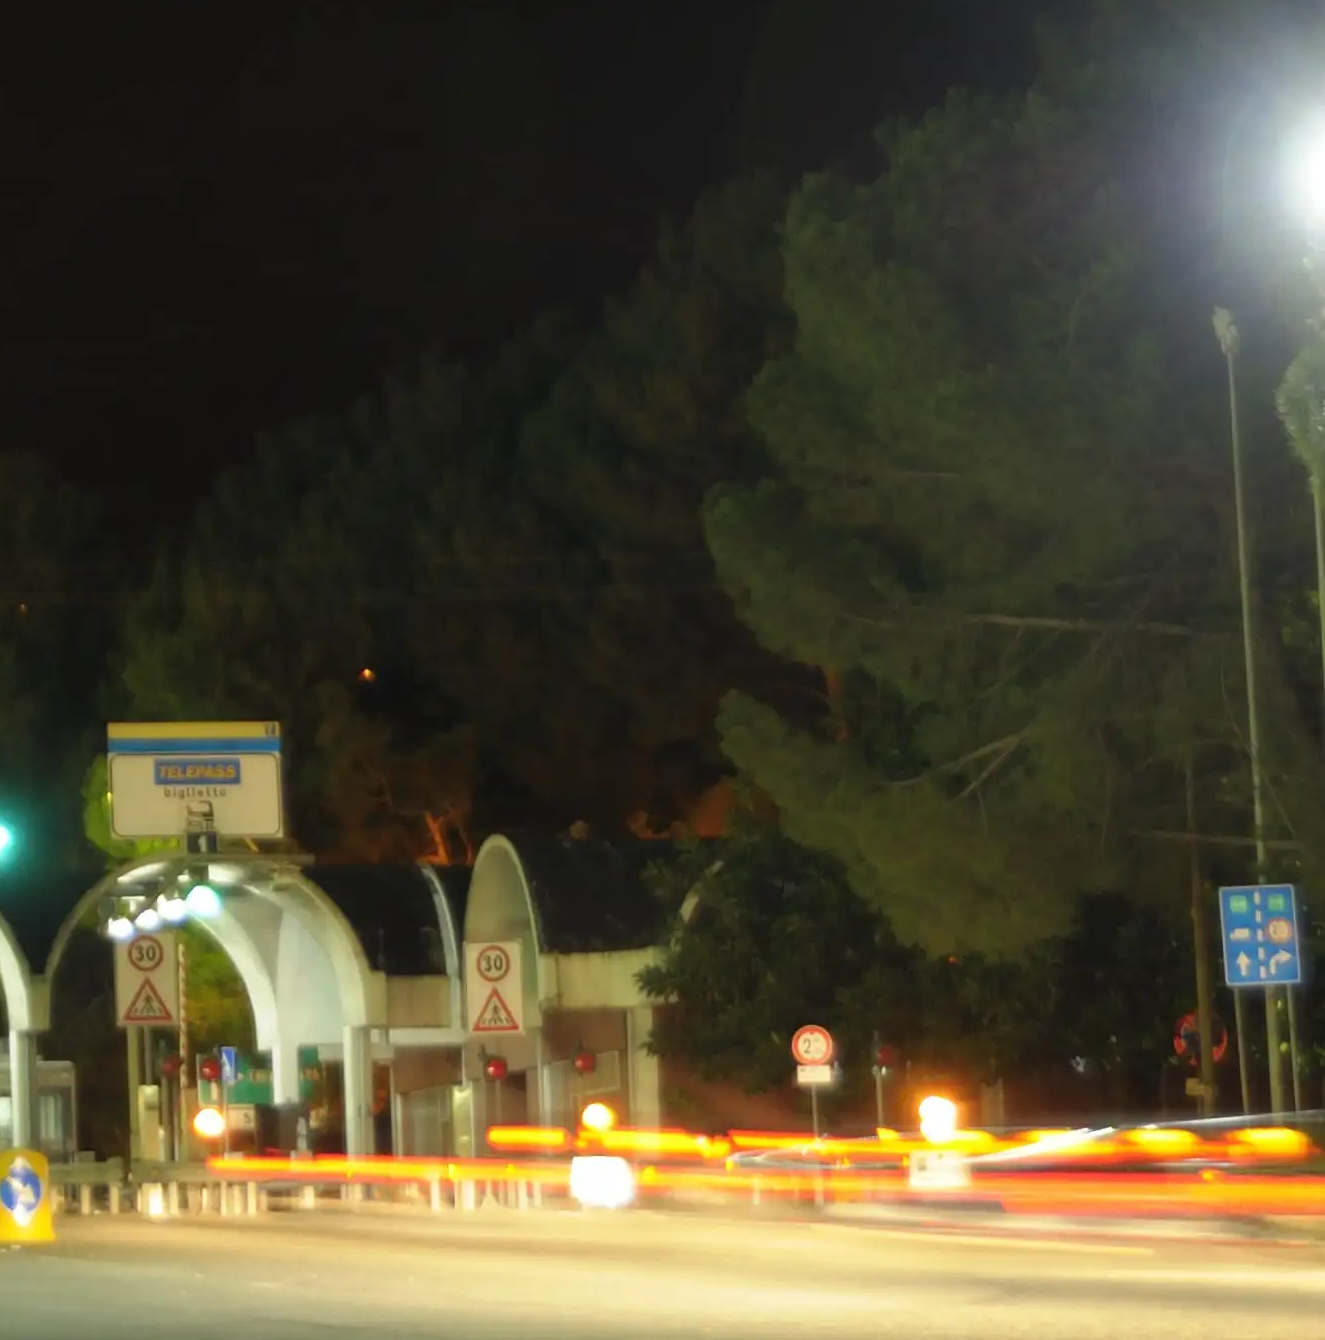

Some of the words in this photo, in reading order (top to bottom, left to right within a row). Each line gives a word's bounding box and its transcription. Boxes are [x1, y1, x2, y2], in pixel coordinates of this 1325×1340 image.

[158, 765, 237, 779] TELEPASS
[135, 943, 156, 962] 30
[483, 954, 504, 972] 30
